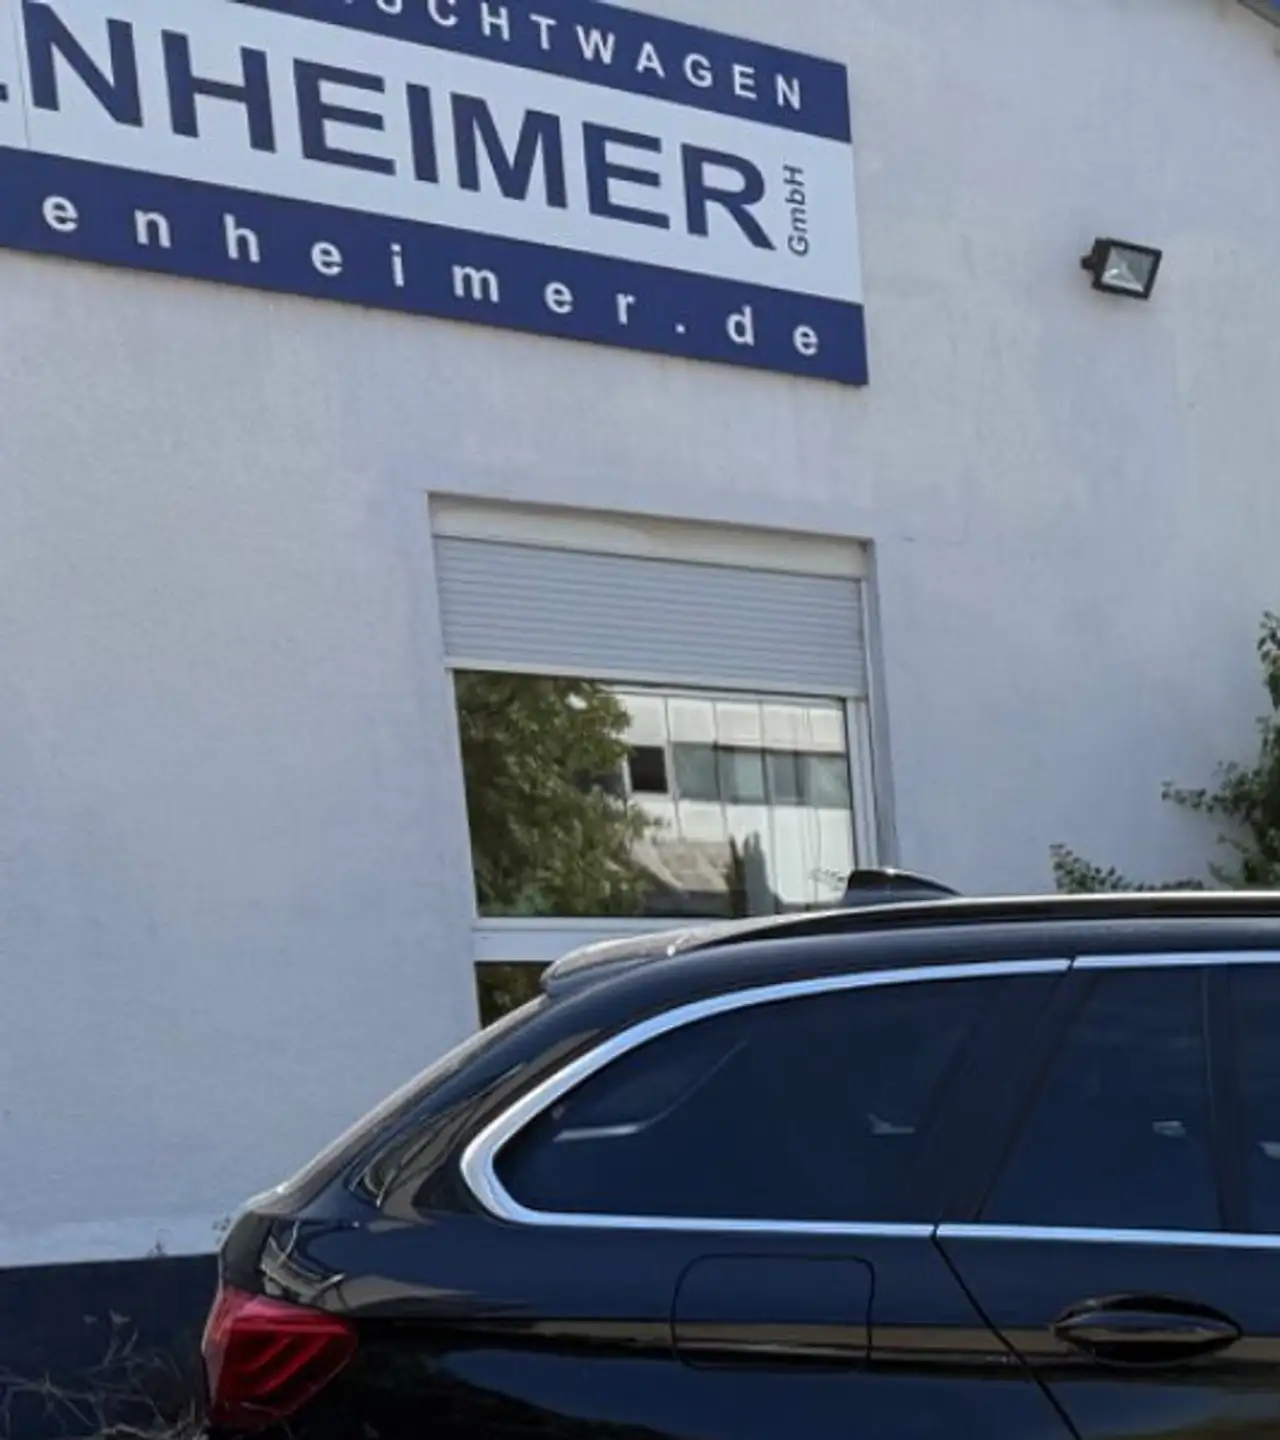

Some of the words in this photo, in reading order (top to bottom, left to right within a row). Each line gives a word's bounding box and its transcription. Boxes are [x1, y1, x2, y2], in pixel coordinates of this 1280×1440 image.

[0, 0, 778, 252] NHEIMER
[42, 193, 820, 356] enheimer.de
[782, 165, 808, 256] GmbH
